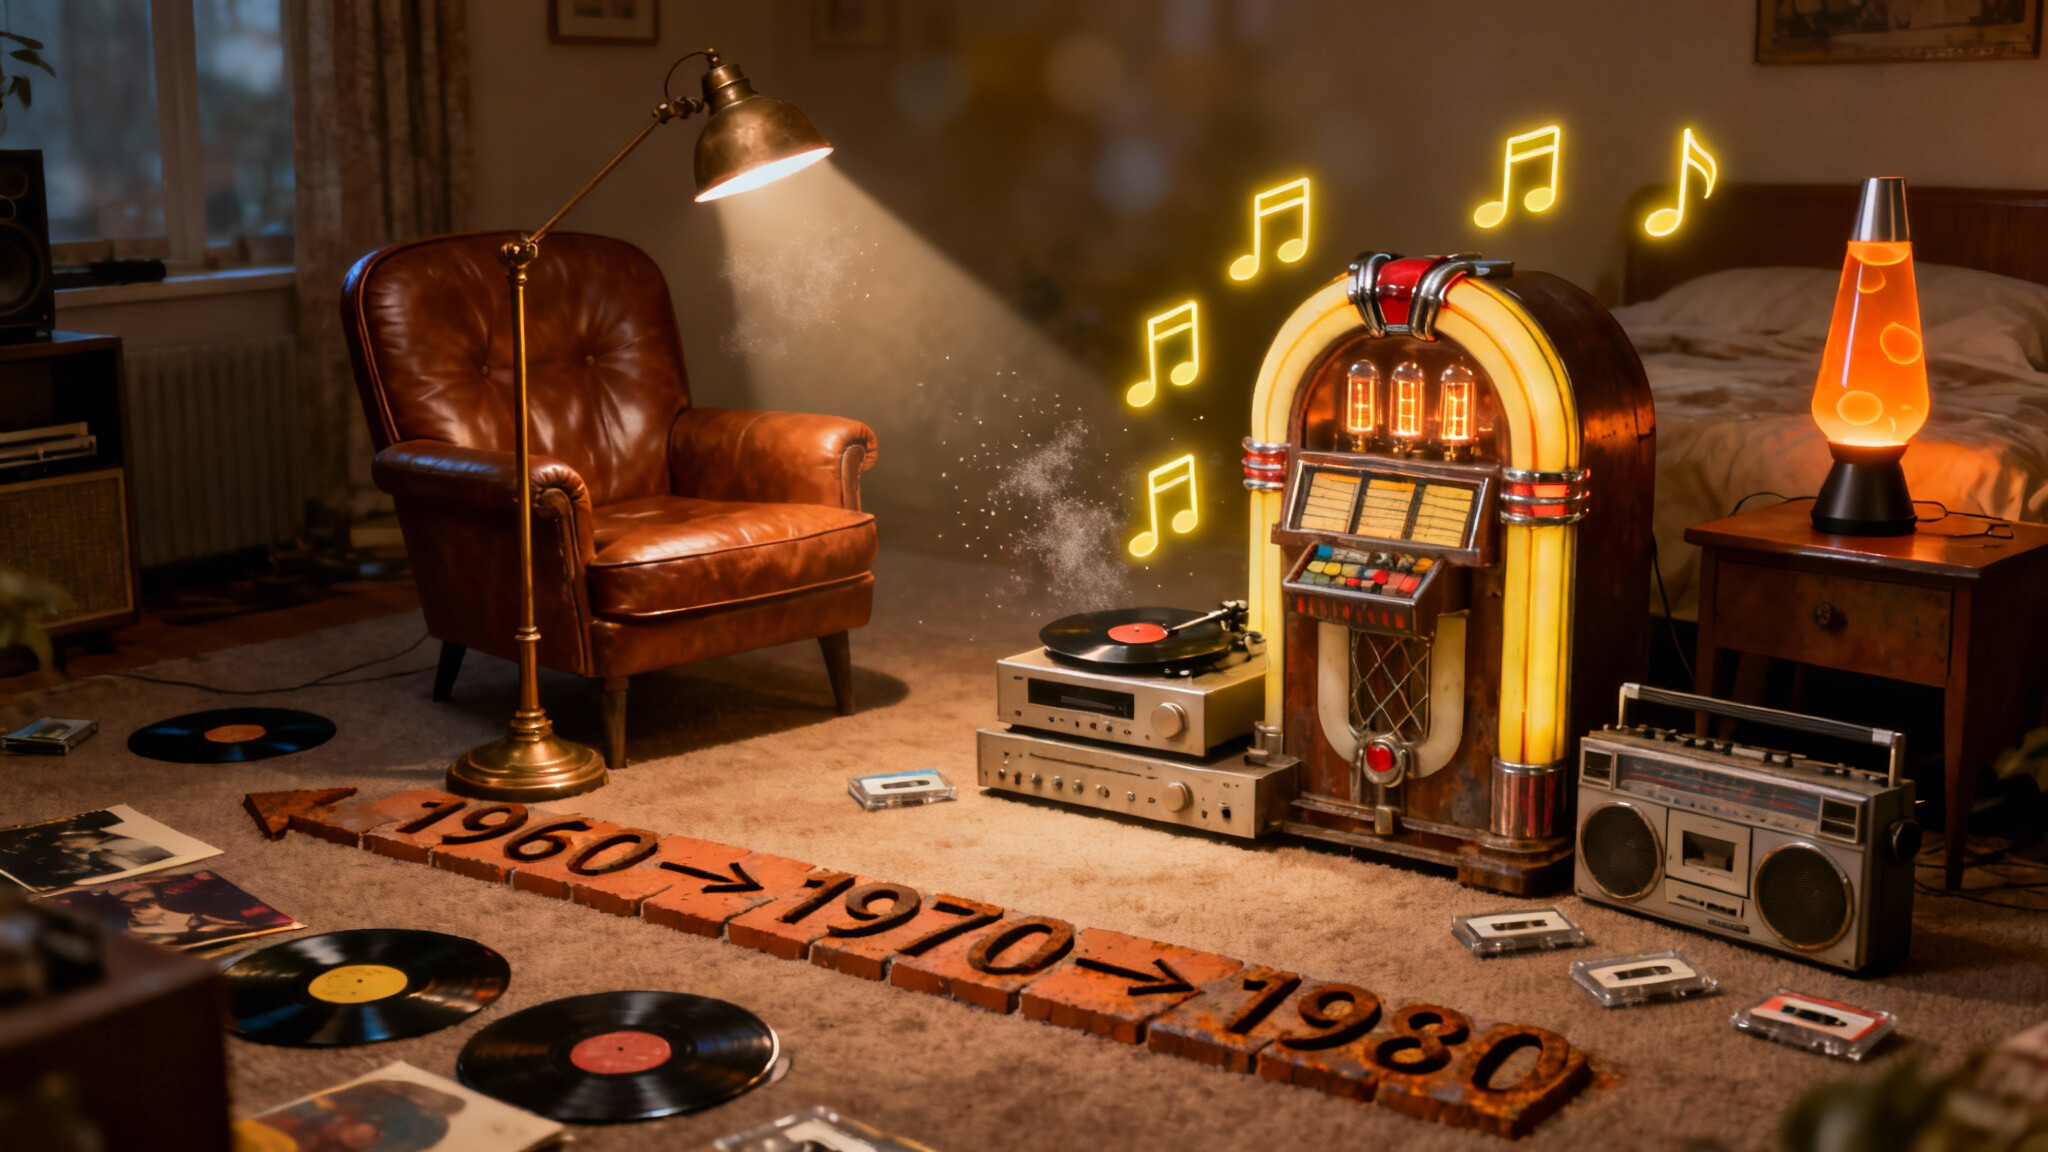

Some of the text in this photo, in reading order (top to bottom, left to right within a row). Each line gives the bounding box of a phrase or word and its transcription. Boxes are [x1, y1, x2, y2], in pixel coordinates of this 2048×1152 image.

[397, 801, 1575, 1103] 1960 1970 1980
